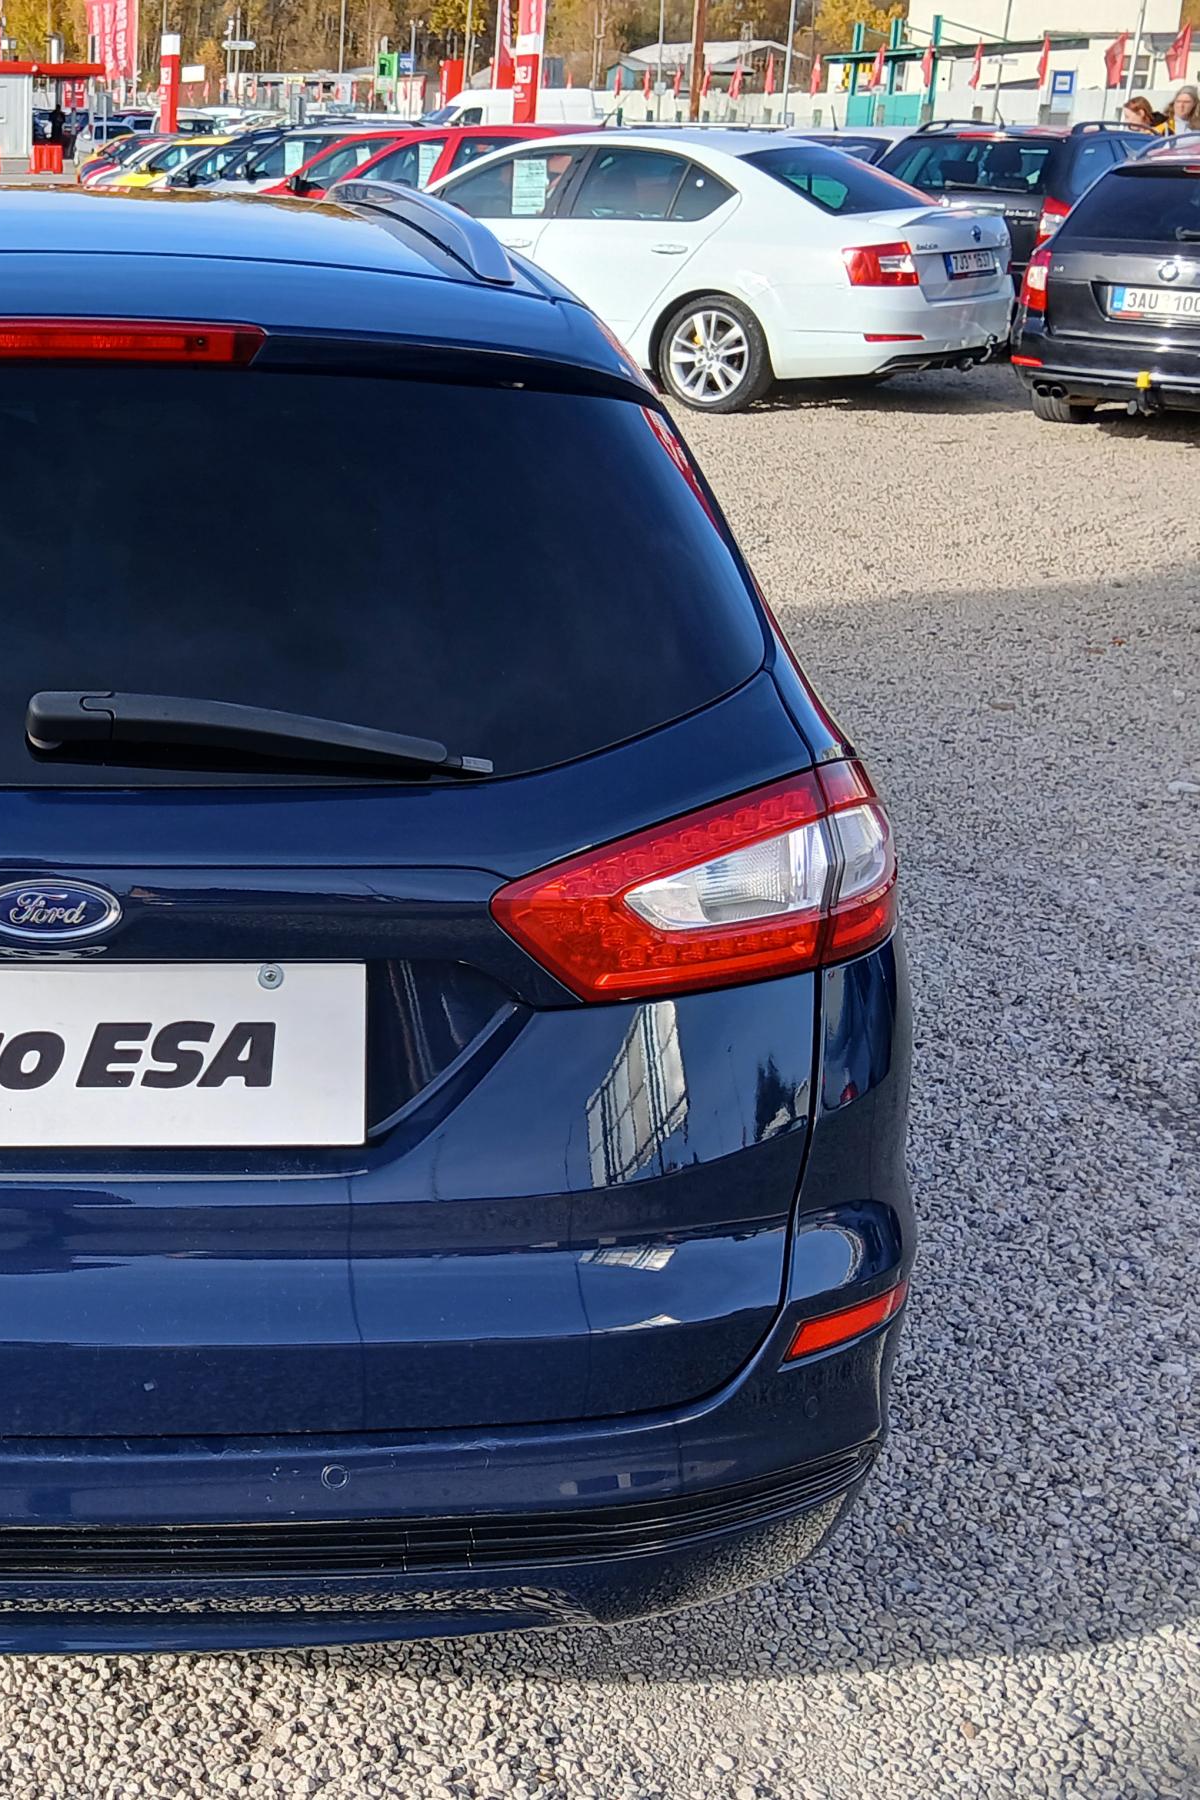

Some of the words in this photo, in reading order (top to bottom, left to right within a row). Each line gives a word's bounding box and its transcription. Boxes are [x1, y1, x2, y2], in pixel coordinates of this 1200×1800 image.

[1127, 292, 1159, 310] 3AU
[9, 892, 87, 925] Ford
[75, 1021, 277, 1089] ESA
